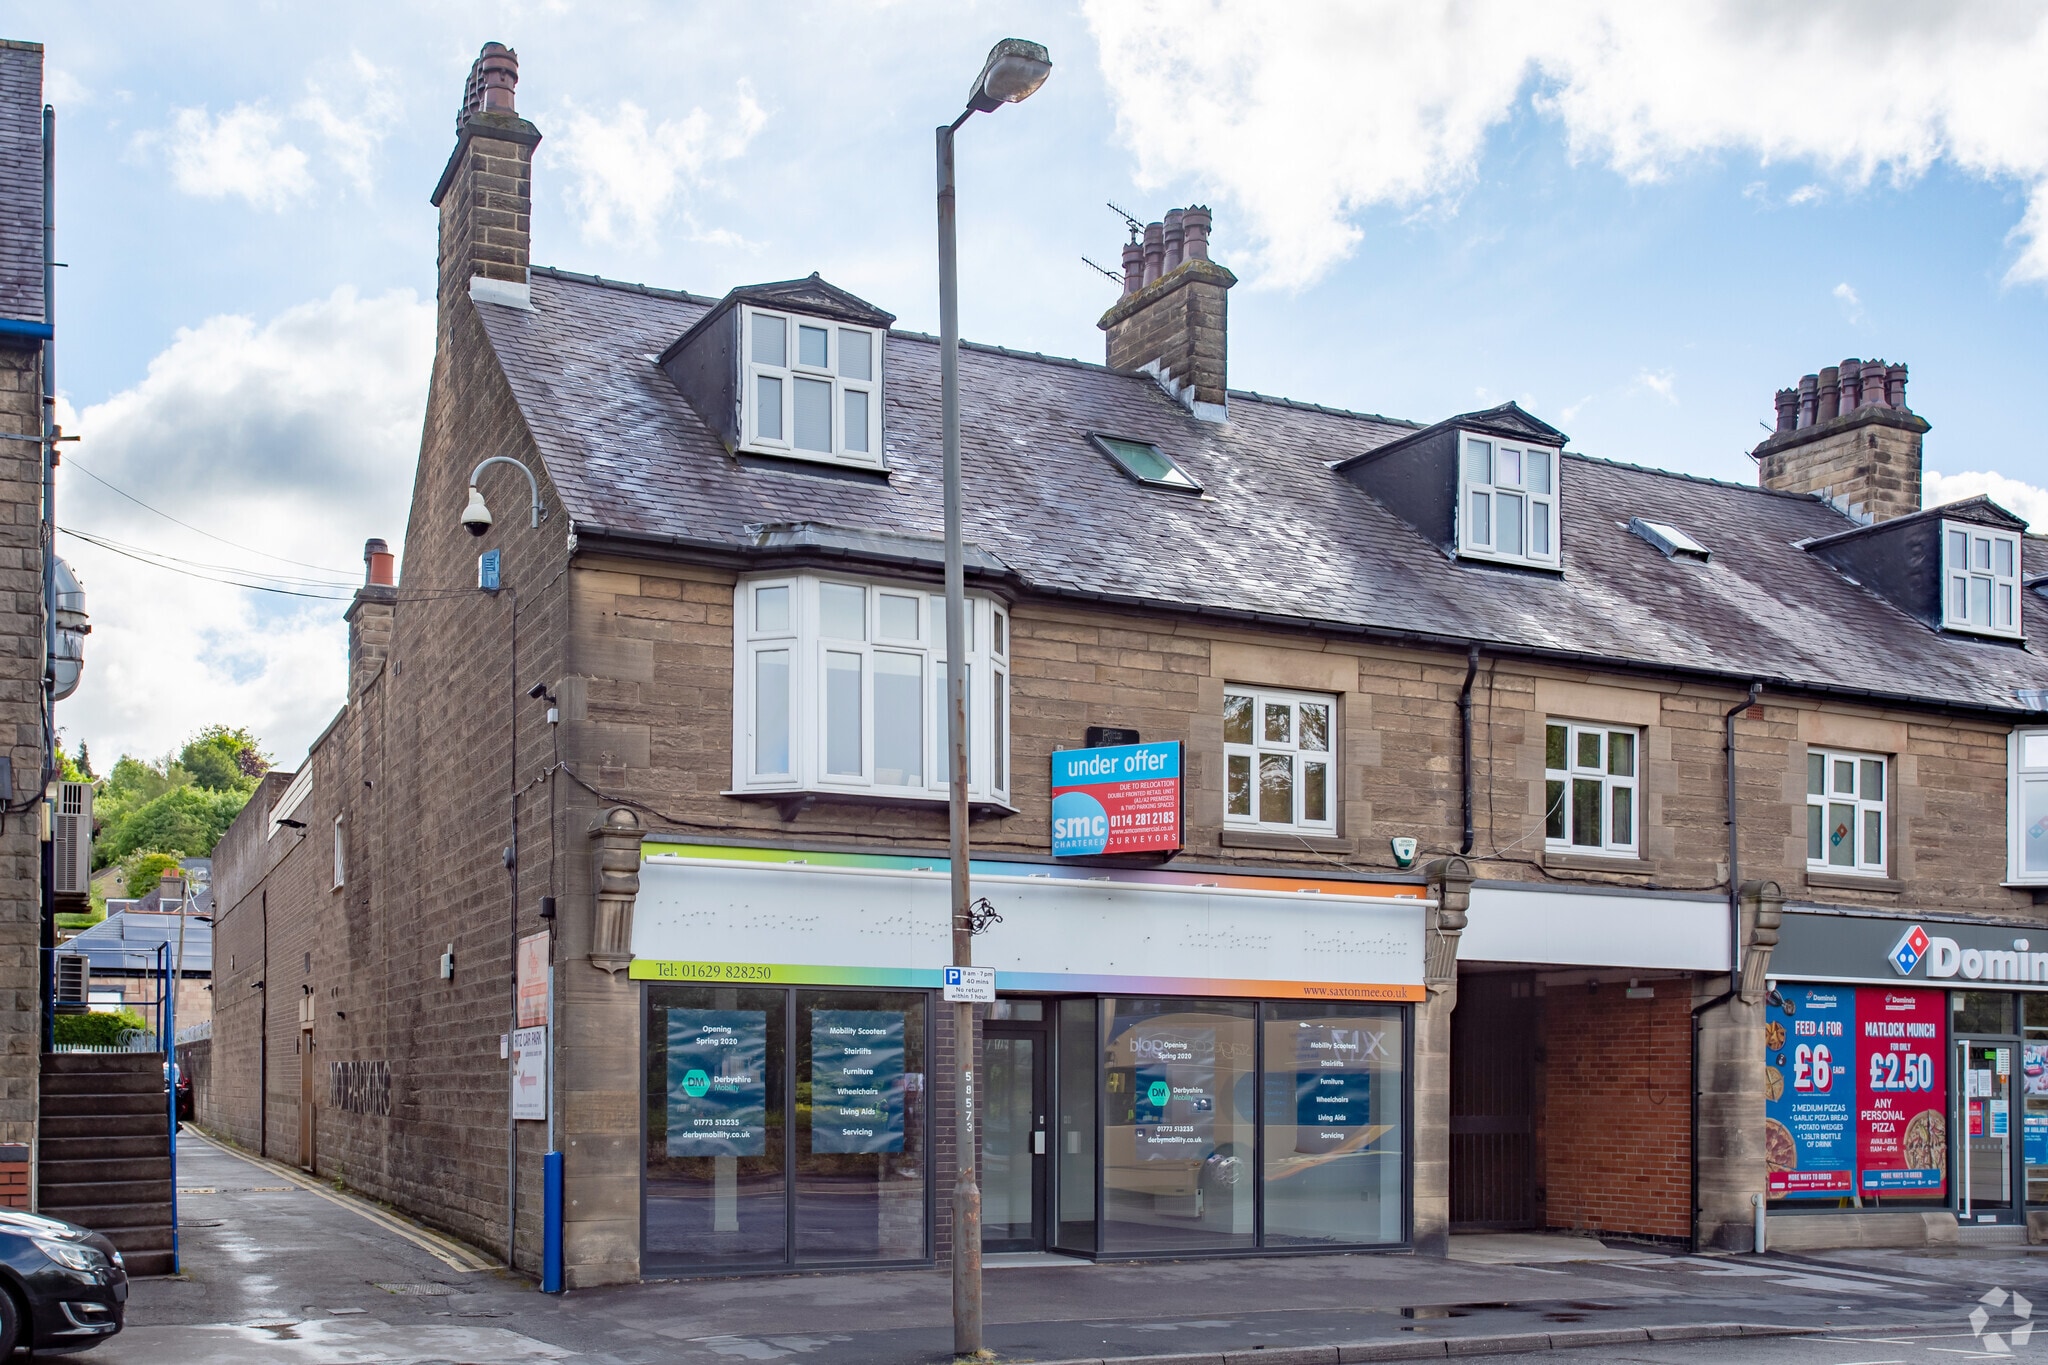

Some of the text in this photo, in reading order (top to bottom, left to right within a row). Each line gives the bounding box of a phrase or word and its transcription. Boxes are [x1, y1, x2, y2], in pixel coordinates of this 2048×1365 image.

[1068, 750, 1168, 776] under offer
[1140, 780, 1174, 789] RELOCATION
[1110, 811, 1174, 827] 0114 281 2183
[1054, 816, 1105, 839] smc
[1111, 826, 1174, 835] www.smcommercial.co.uk
[1054, 834, 1176, 848] CHARTERED SURVEYORS
[656, 963, 771, 979] Tel: 01629 828250
[949, 970, 958, 984] P
[1304, 987, 1408, 998] www.saxtonmee.co.uk
[702, 1026, 732, 1034] Opening
[830, 1028, 856, 1036] Mobility
[1795, 1020, 1842, 1036] FEED 4 FOR
[1865, 1022, 1936, 1038] MATLOCK MUNCH
[696, 1038, 718, 1046] Spring
[1164, 1041, 1187, 1050] Opening
[1311, 1042, 1332, 1050] Mobility
[1890, 1042, 1911, 1050] FOR ONLY
[1158, 1052, 1176, 1060] Spring
[1794, 1044, 1831, 1090] £6
[1870, 1052, 1932, 1090] £2.50
[687, 1078, 704, 1086] DM
[714, 1076, 752, 1084] Derbyshire
[330, 1061, 391, 1116] NO PARKING
[714, 1084, 740, 1092] Mobility
[1152, 1088, 1166, 1097] DM
[1173, 1086, 1204, 1094] Derbyshire
[1874, 1098, 1892, 1108] ANY
[840, 1108, 860, 1116] Living
[1862, 1110, 1905, 1120] PERSONAL
[1872, 1122, 1895, 1132] PIZZA
[682, 1131, 750, 1140] derbymobility.co.uk
[842, 1128, 872, 1136] Servicing
[1148, 1136, 1202, 1144] derbymobility.co.uk
